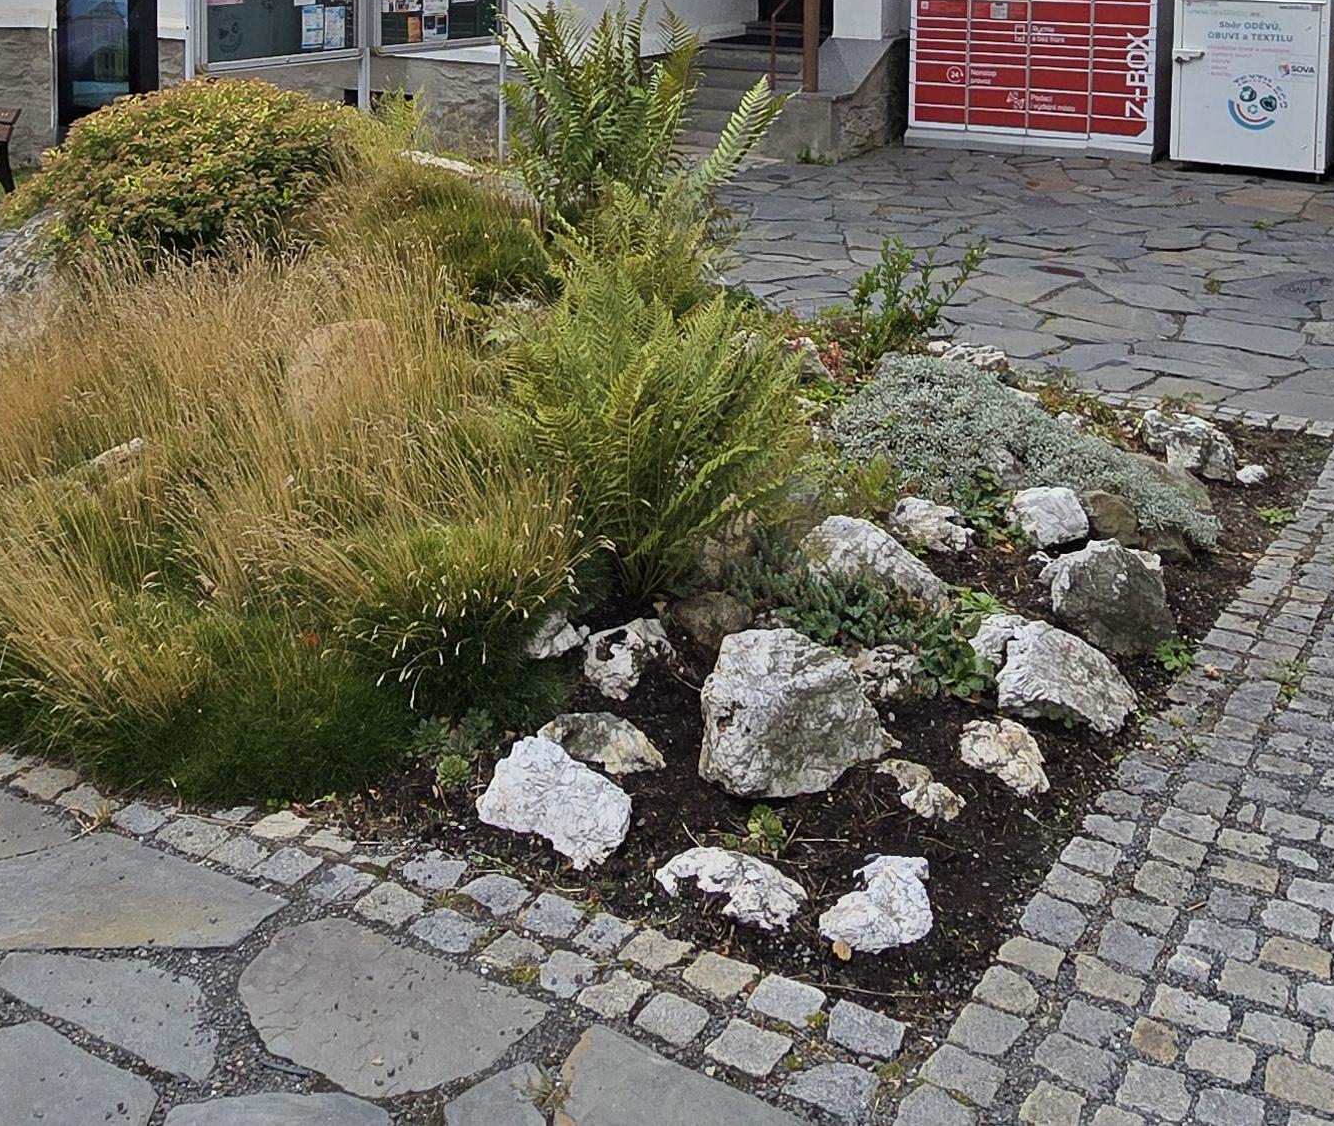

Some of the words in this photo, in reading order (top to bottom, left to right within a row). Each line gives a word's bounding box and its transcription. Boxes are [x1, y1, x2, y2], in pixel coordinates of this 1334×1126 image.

[1219, 20, 1241, 30] Sběr
[1244, 20, 1282, 32] ODĚVŮ,
[1208, 31, 1239, 41] OBUVI
[1242, 33, 1248, 41] a
[1251, 32, 1294, 42] TEXTILU
[1125, 32, 1149, 117] Z-BOX
[1291, 64, 1315, 74] SOVA
